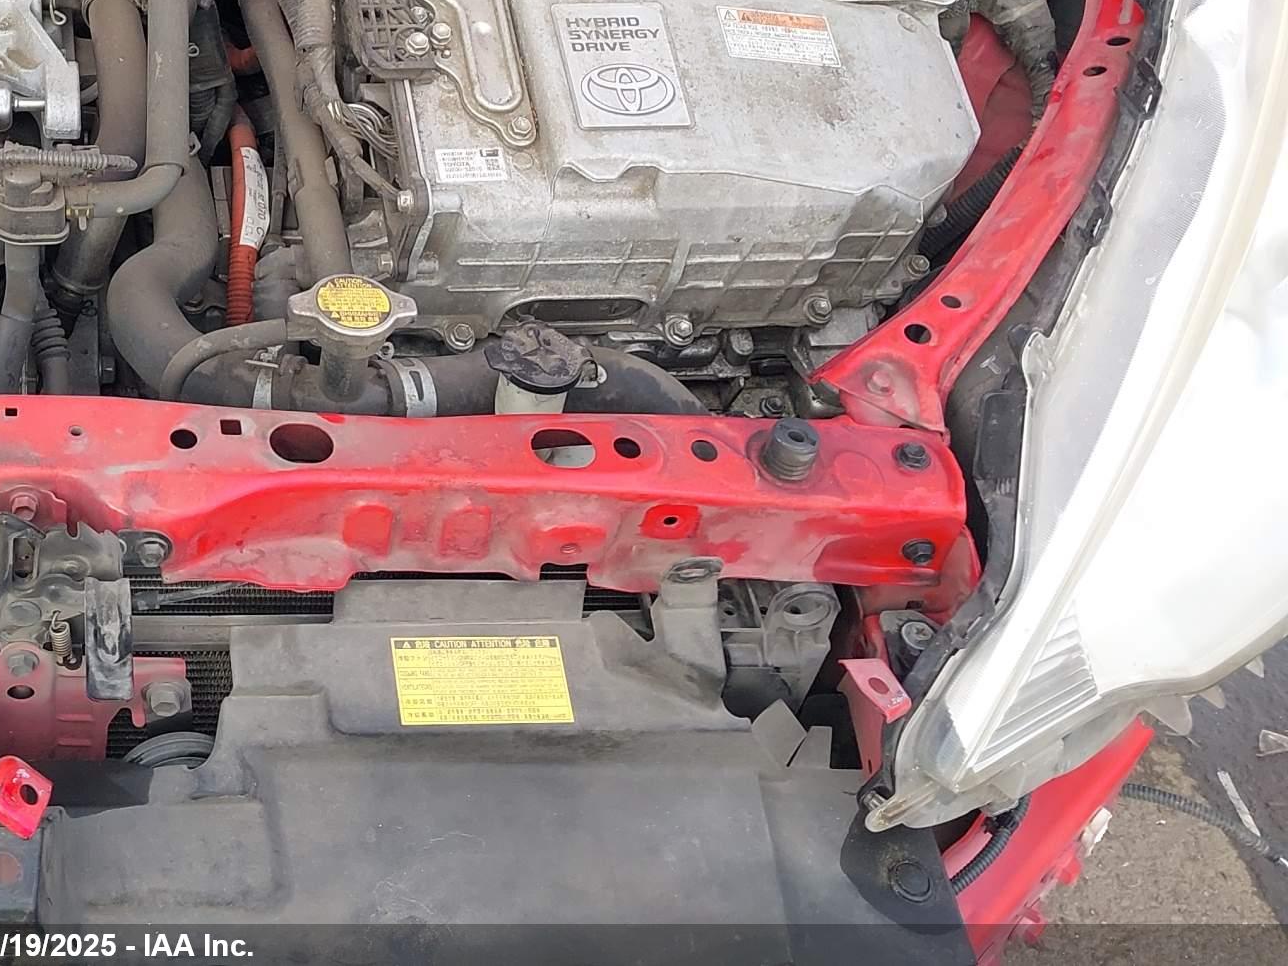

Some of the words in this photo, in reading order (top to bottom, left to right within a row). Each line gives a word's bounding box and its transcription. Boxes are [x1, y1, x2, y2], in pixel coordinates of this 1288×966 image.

[566, 17, 640, 27] HYBRID
[569, 29, 660, 40] SYNERGY
[572, 41, 631, 52] DRIVE
[434, 640, 467, 648] CAUTION
[470, 640, 512, 648] ATTENTION
